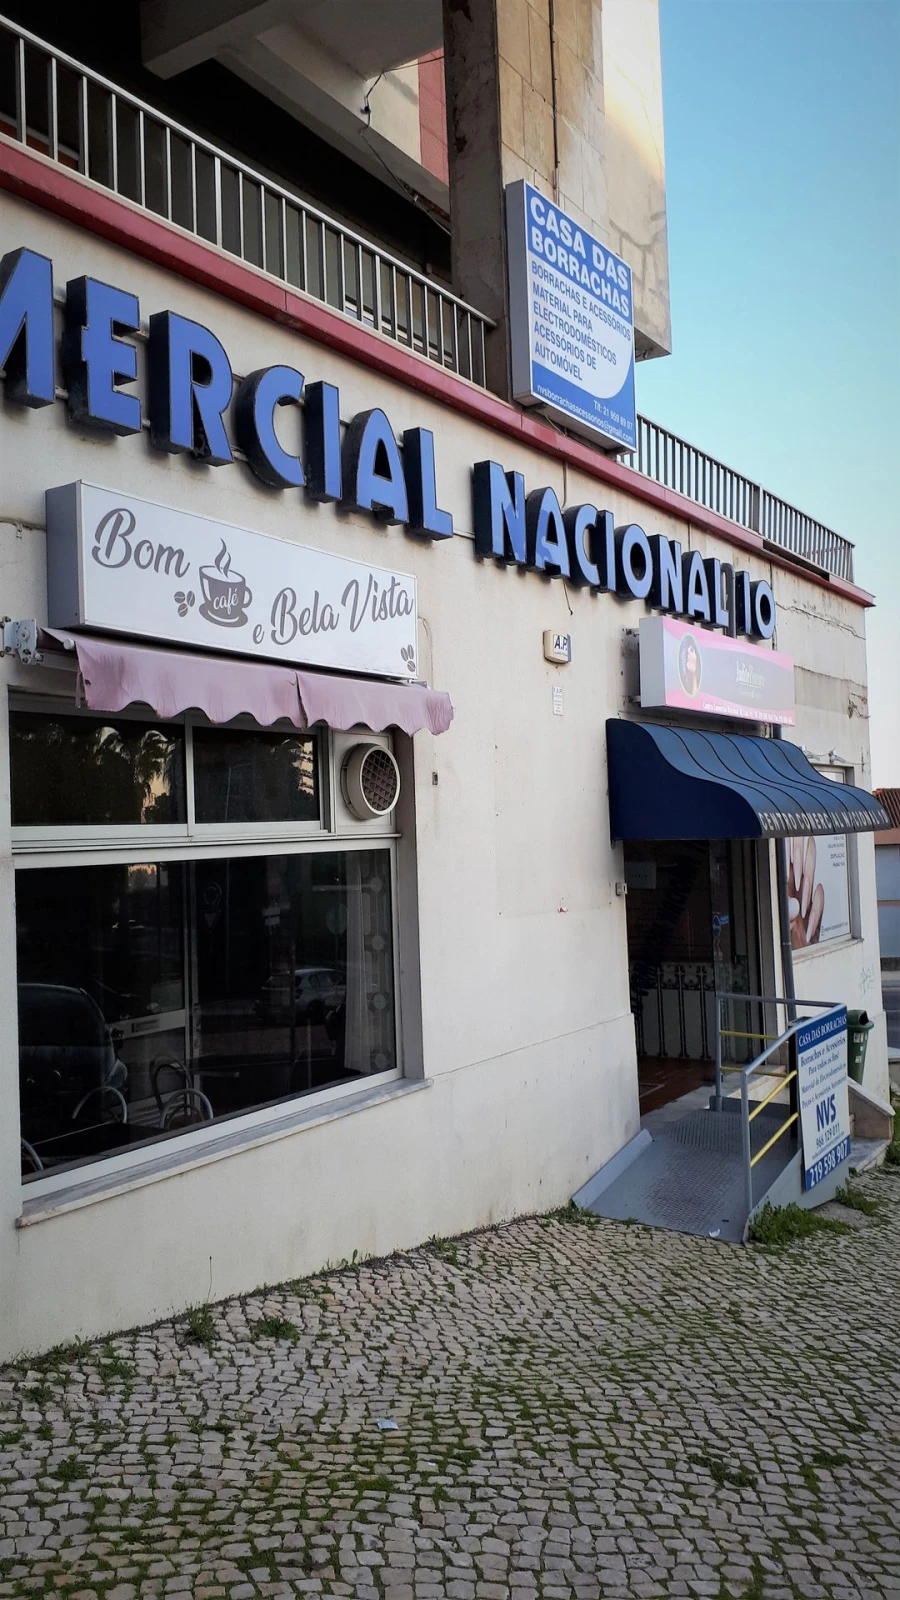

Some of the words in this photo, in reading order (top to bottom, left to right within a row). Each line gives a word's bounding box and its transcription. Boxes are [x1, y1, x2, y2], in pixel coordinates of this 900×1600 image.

[530, 196, 587, 259] CASA
[592, 245, 629, 292] DAS
[531, 226, 630, 319] BORRACHAS
[531, 261, 581, 306] BORRACHAS
[583, 296, 588, 310] E
[589, 299, 632, 342] ACESSÓRIOS
[532, 284, 572, 319] MATERIAL
[573, 309, 593, 332] PARA
[533, 302, 617, 366] ELECTRODOMÉSTICOS
[534, 320, 585, 365] ACESSÓRIOS
[586, 353, 597, 371] DE
[534, 341, 583, 381] AUTOMÓVEL
[92, 508, 190, 578] Bom
[474, 460, 729, 629] NACIONAL
[213, 587, 239, 616] café
[252, 621, 265, 645] e
[271, 587, 340, 646] Bela
[341, 573, 414, 633] Vista
[758, 812, 797, 831] CENTRO
[795, 811, 844, 830] COMERCIAL
[841, 810, 880, 828] NACIONAL
[798, 1032, 811, 1047] CASA
[811, 1026, 821, 1041] DAS
[820, 1014, 847, 1037] BORRACHAS
[801, 1049, 822, 1067] Borrachas
[816, 1094, 836, 1132] NVS
[809, 1160, 823, 1188] 219
[823, 1149, 836, 1175] 598
[836, 1138, 848, 1163] 907
